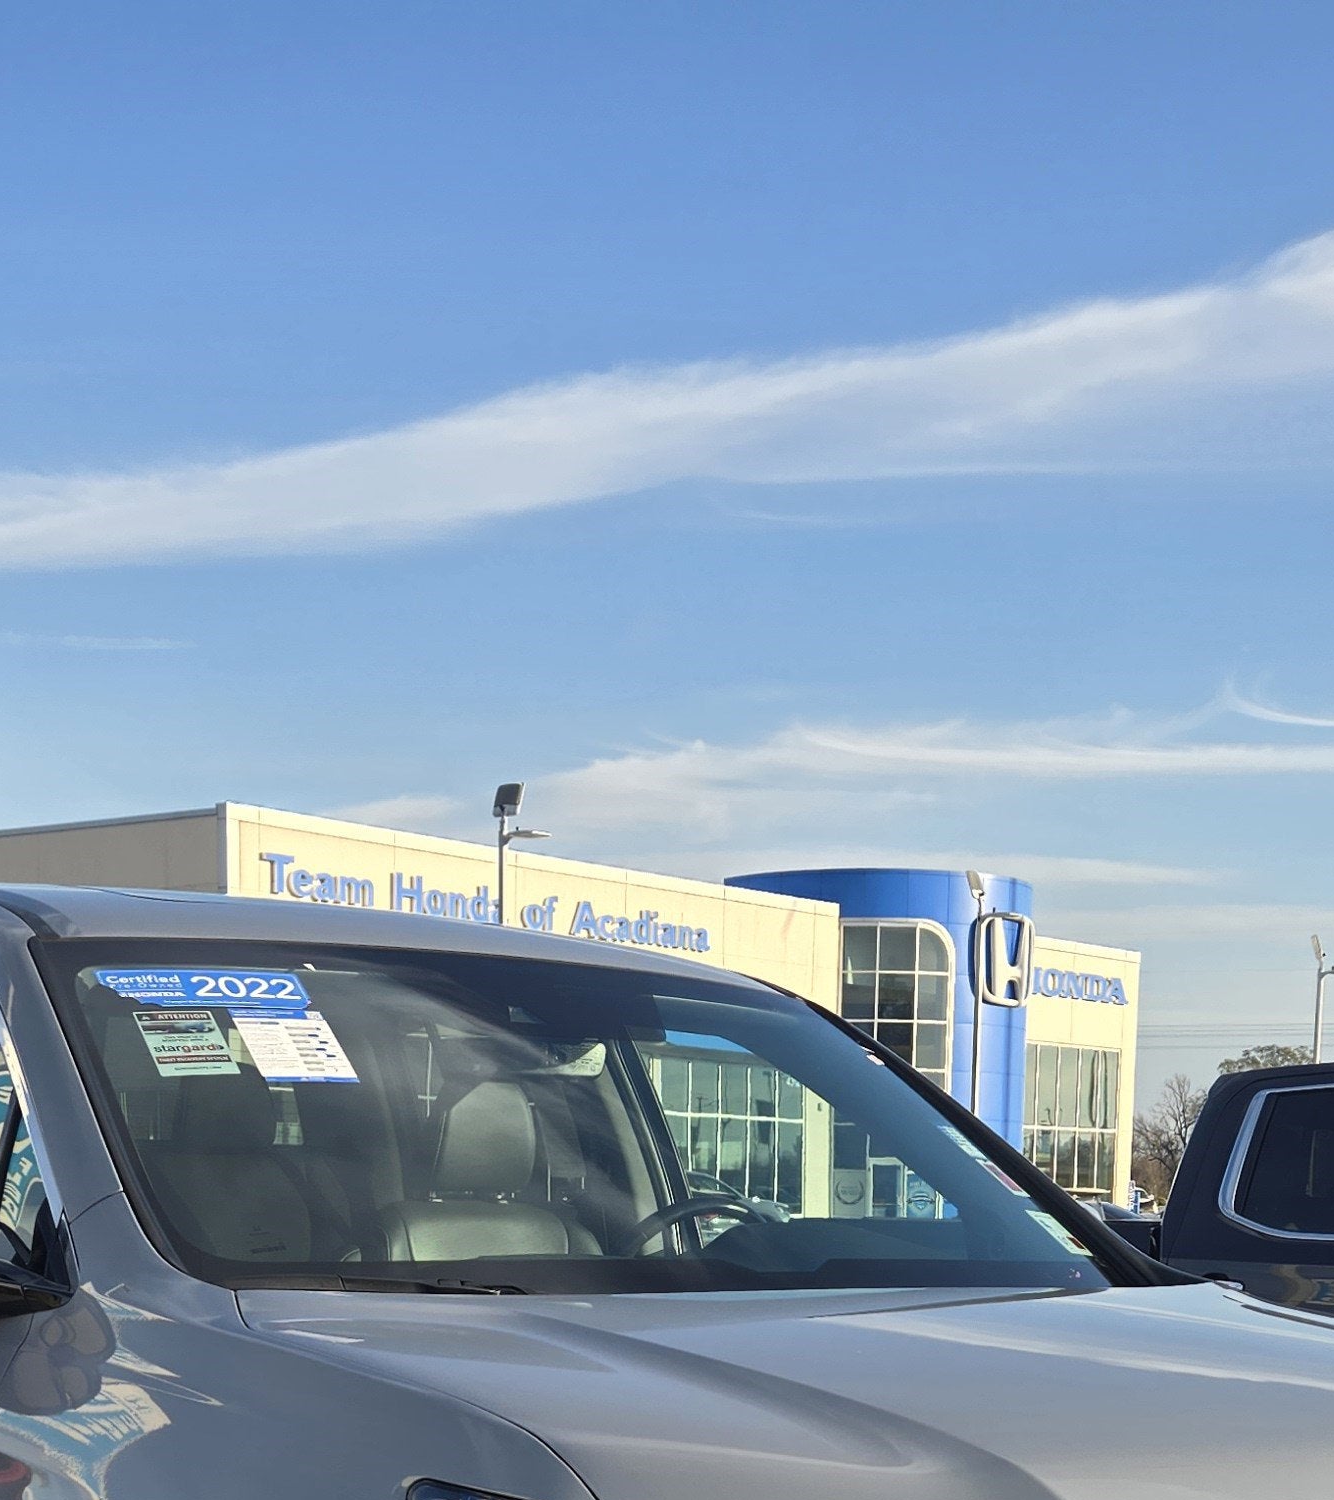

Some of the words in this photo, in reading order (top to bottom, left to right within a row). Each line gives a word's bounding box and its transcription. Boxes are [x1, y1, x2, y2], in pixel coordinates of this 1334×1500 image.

[259, 852, 374, 908] Team
[521, 895, 558, 931] of
[569, 900, 711, 953] Acadiana
[190, 975, 302, 1000] 2022
[157, 1013, 208, 1021] ATTENTION
